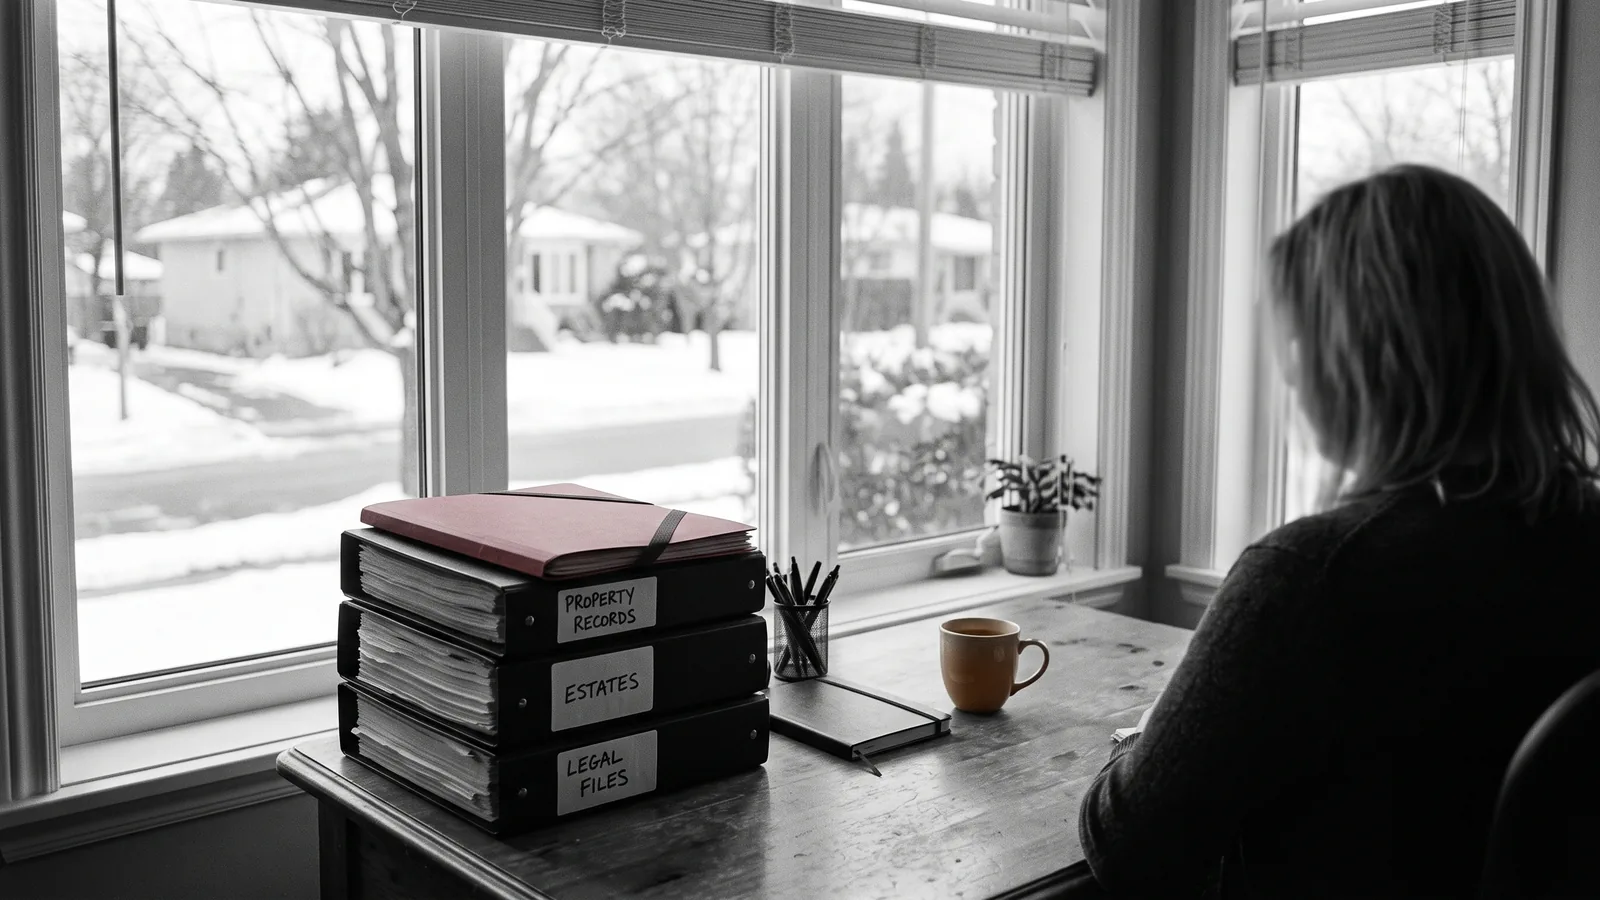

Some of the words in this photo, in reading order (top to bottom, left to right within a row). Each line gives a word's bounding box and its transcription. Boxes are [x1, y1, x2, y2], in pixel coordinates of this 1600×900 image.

[565, 587, 635, 613] PROPERTY
[574, 609, 637, 634] RECORDS
[565, 673, 640, 704] ESTATES
[567, 750, 624, 777] LEGAL
[580, 769, 629, 798] FILES
